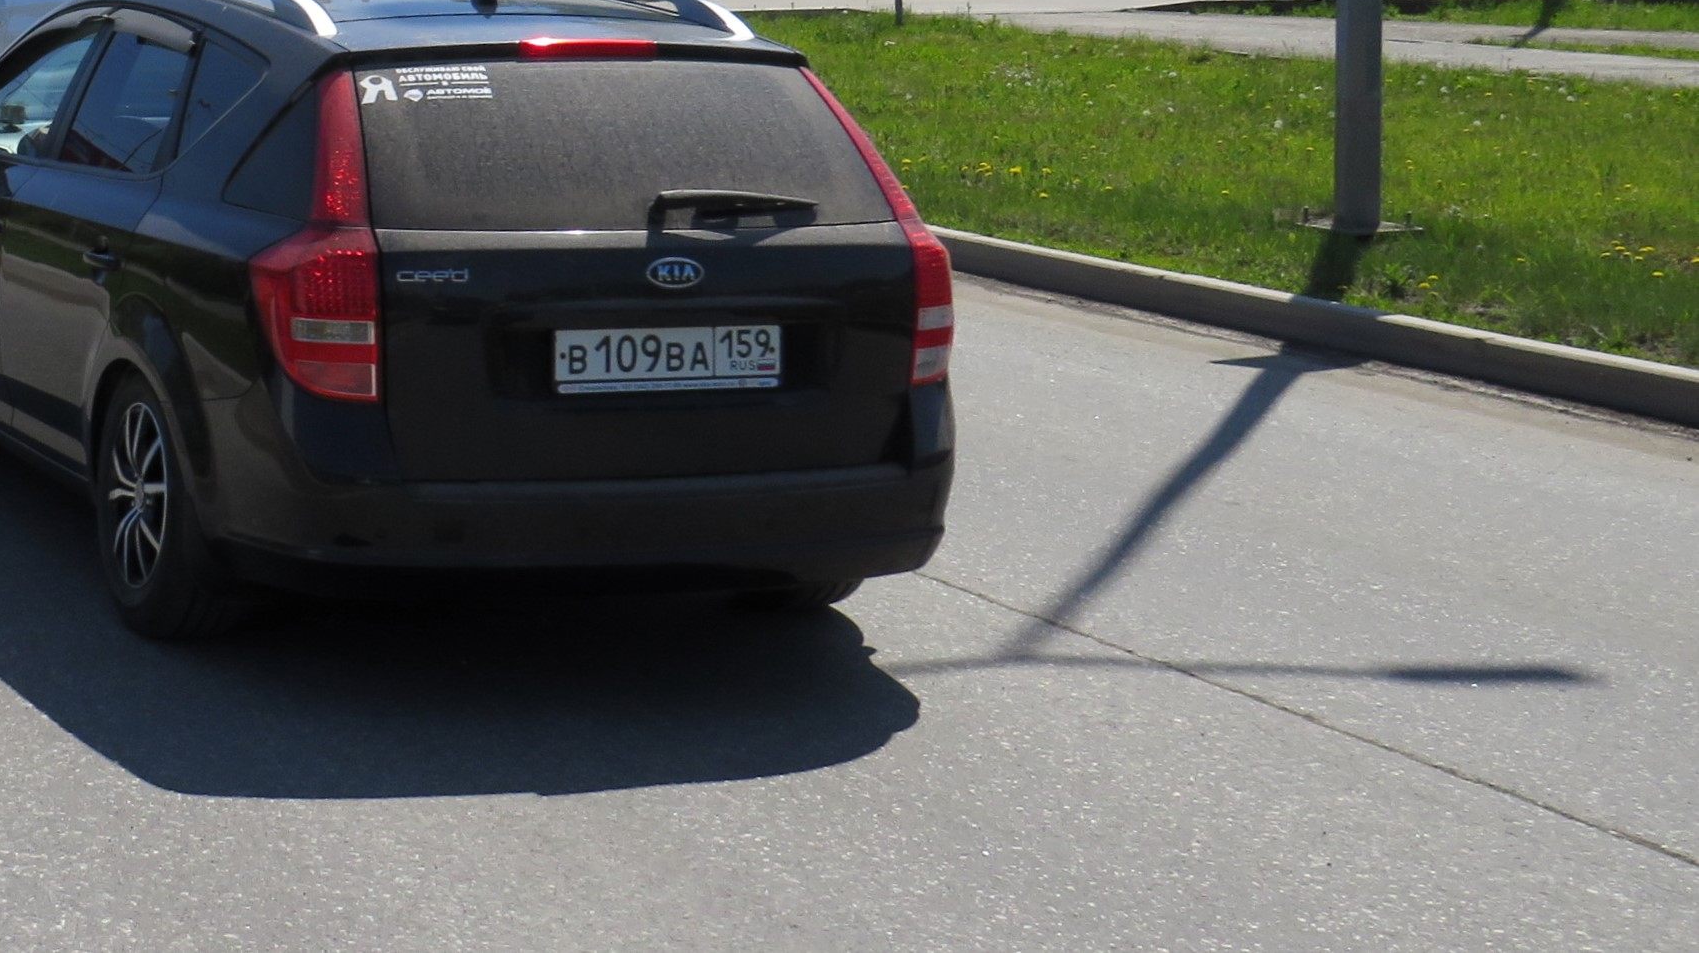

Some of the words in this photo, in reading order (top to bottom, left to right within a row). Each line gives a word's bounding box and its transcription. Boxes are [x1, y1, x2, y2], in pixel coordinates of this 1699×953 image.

[398, 72, 489, 82] АВТОМОБИЛЬ
[657, 264, 695, 281] KIA
[718, 329, 771, 359] 159
[730, 360, 756, 371] RUS
